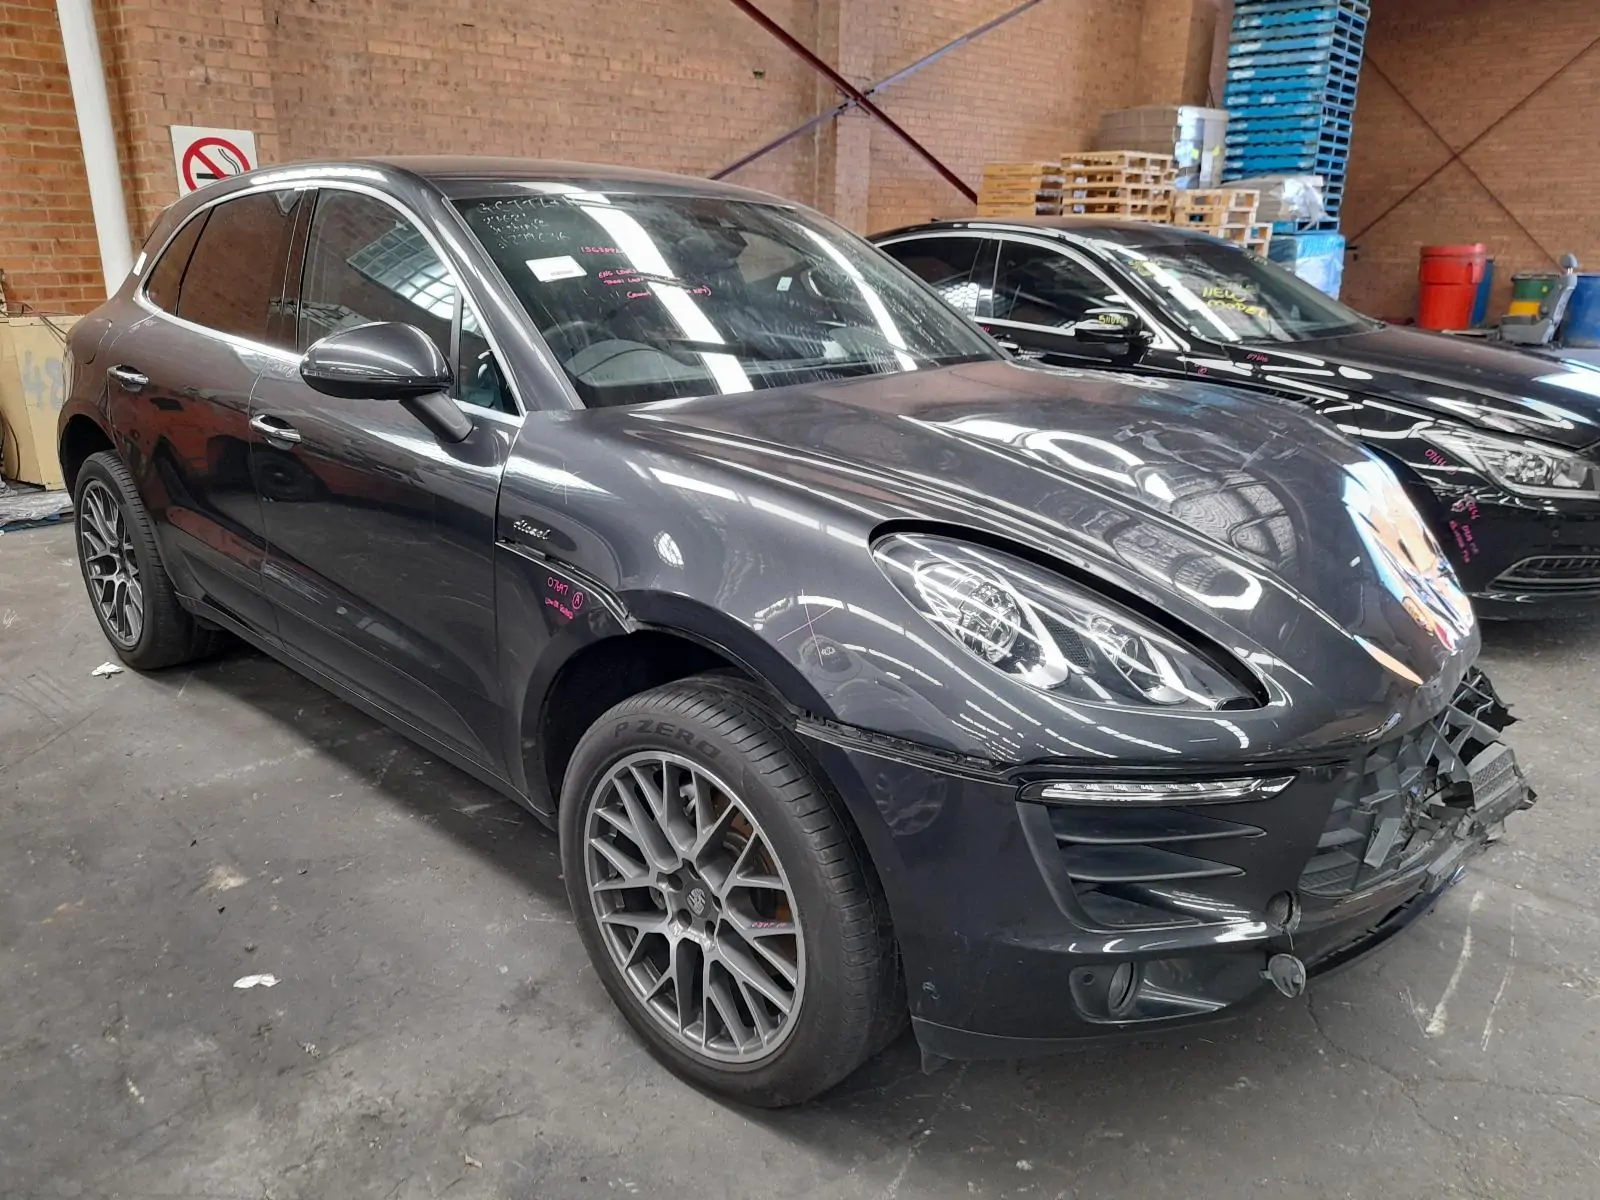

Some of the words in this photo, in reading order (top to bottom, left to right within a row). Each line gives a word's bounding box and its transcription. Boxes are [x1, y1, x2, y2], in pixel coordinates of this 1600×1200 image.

[513, 519, 551, 540] diesel
[614, 721, 630, 738] P
[635, 719, 722, 759] ZERO
